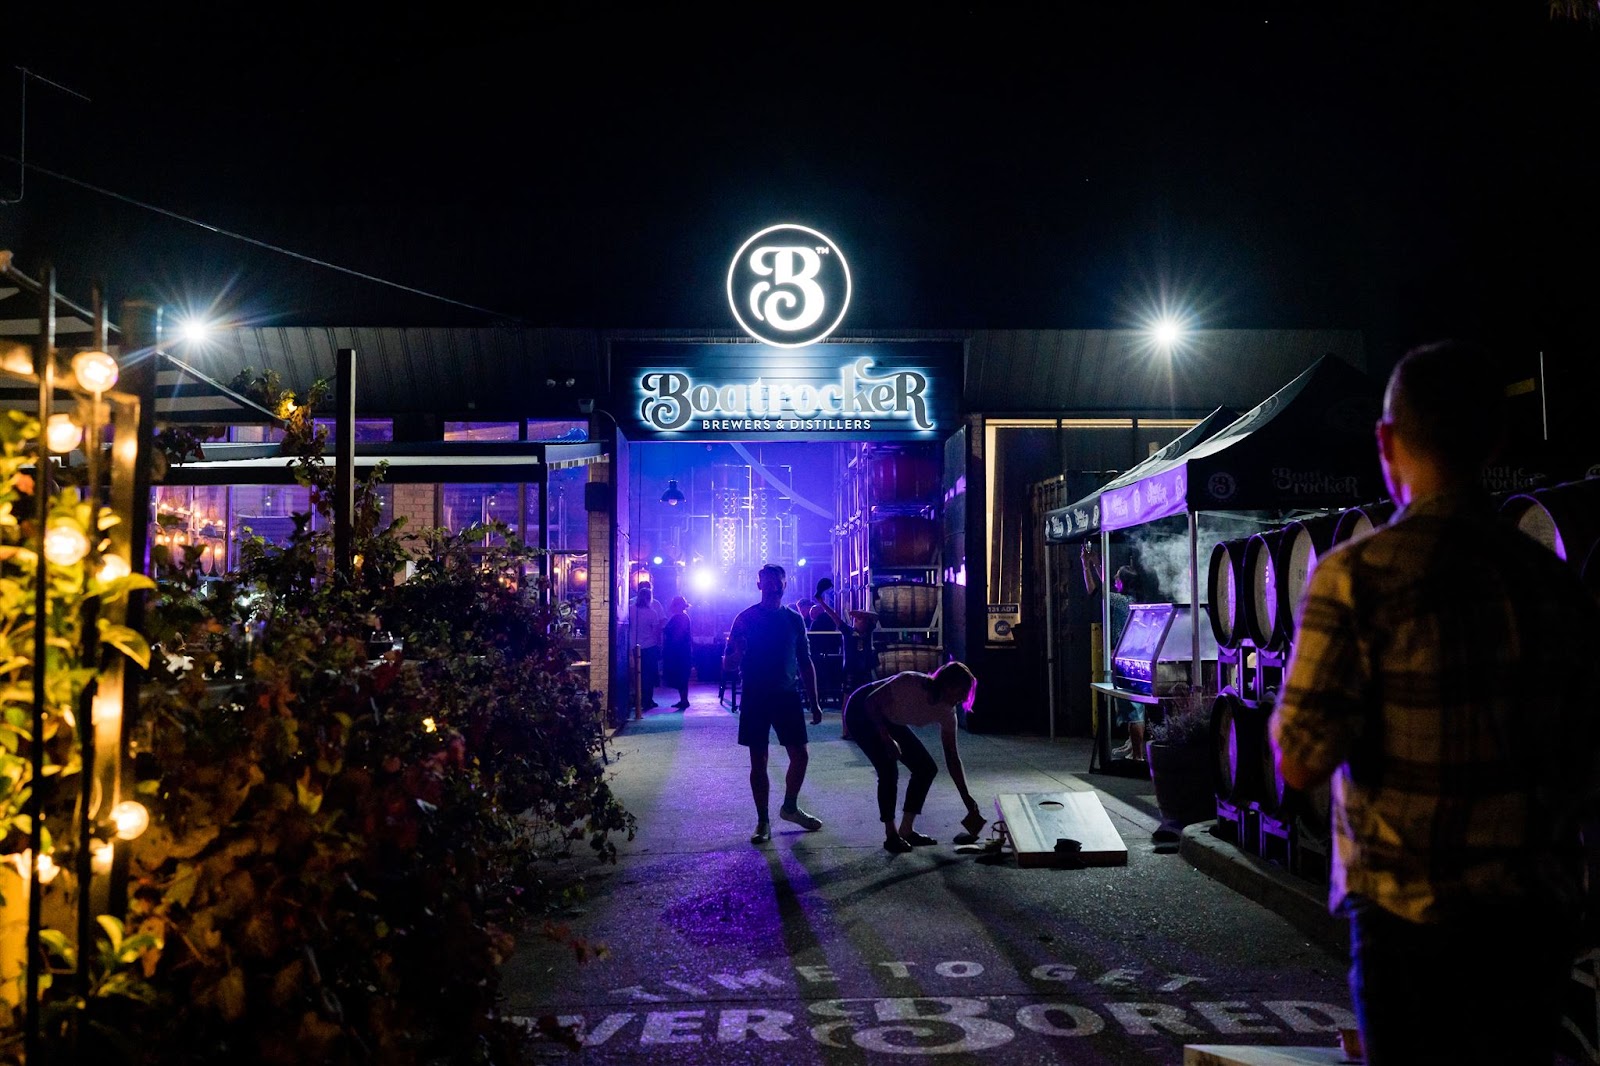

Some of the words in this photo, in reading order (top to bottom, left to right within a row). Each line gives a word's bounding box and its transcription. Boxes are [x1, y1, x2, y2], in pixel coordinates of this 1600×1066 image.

[749, 246, 825, 331] B
[702, 420, 770, 430] BREWERS
[776, 420, 785, 430] &
[790, 420, 871, 430] DISTILLERS
[891, 961, 985, 979] TO
[1030, 963, 1208, 992] GET
